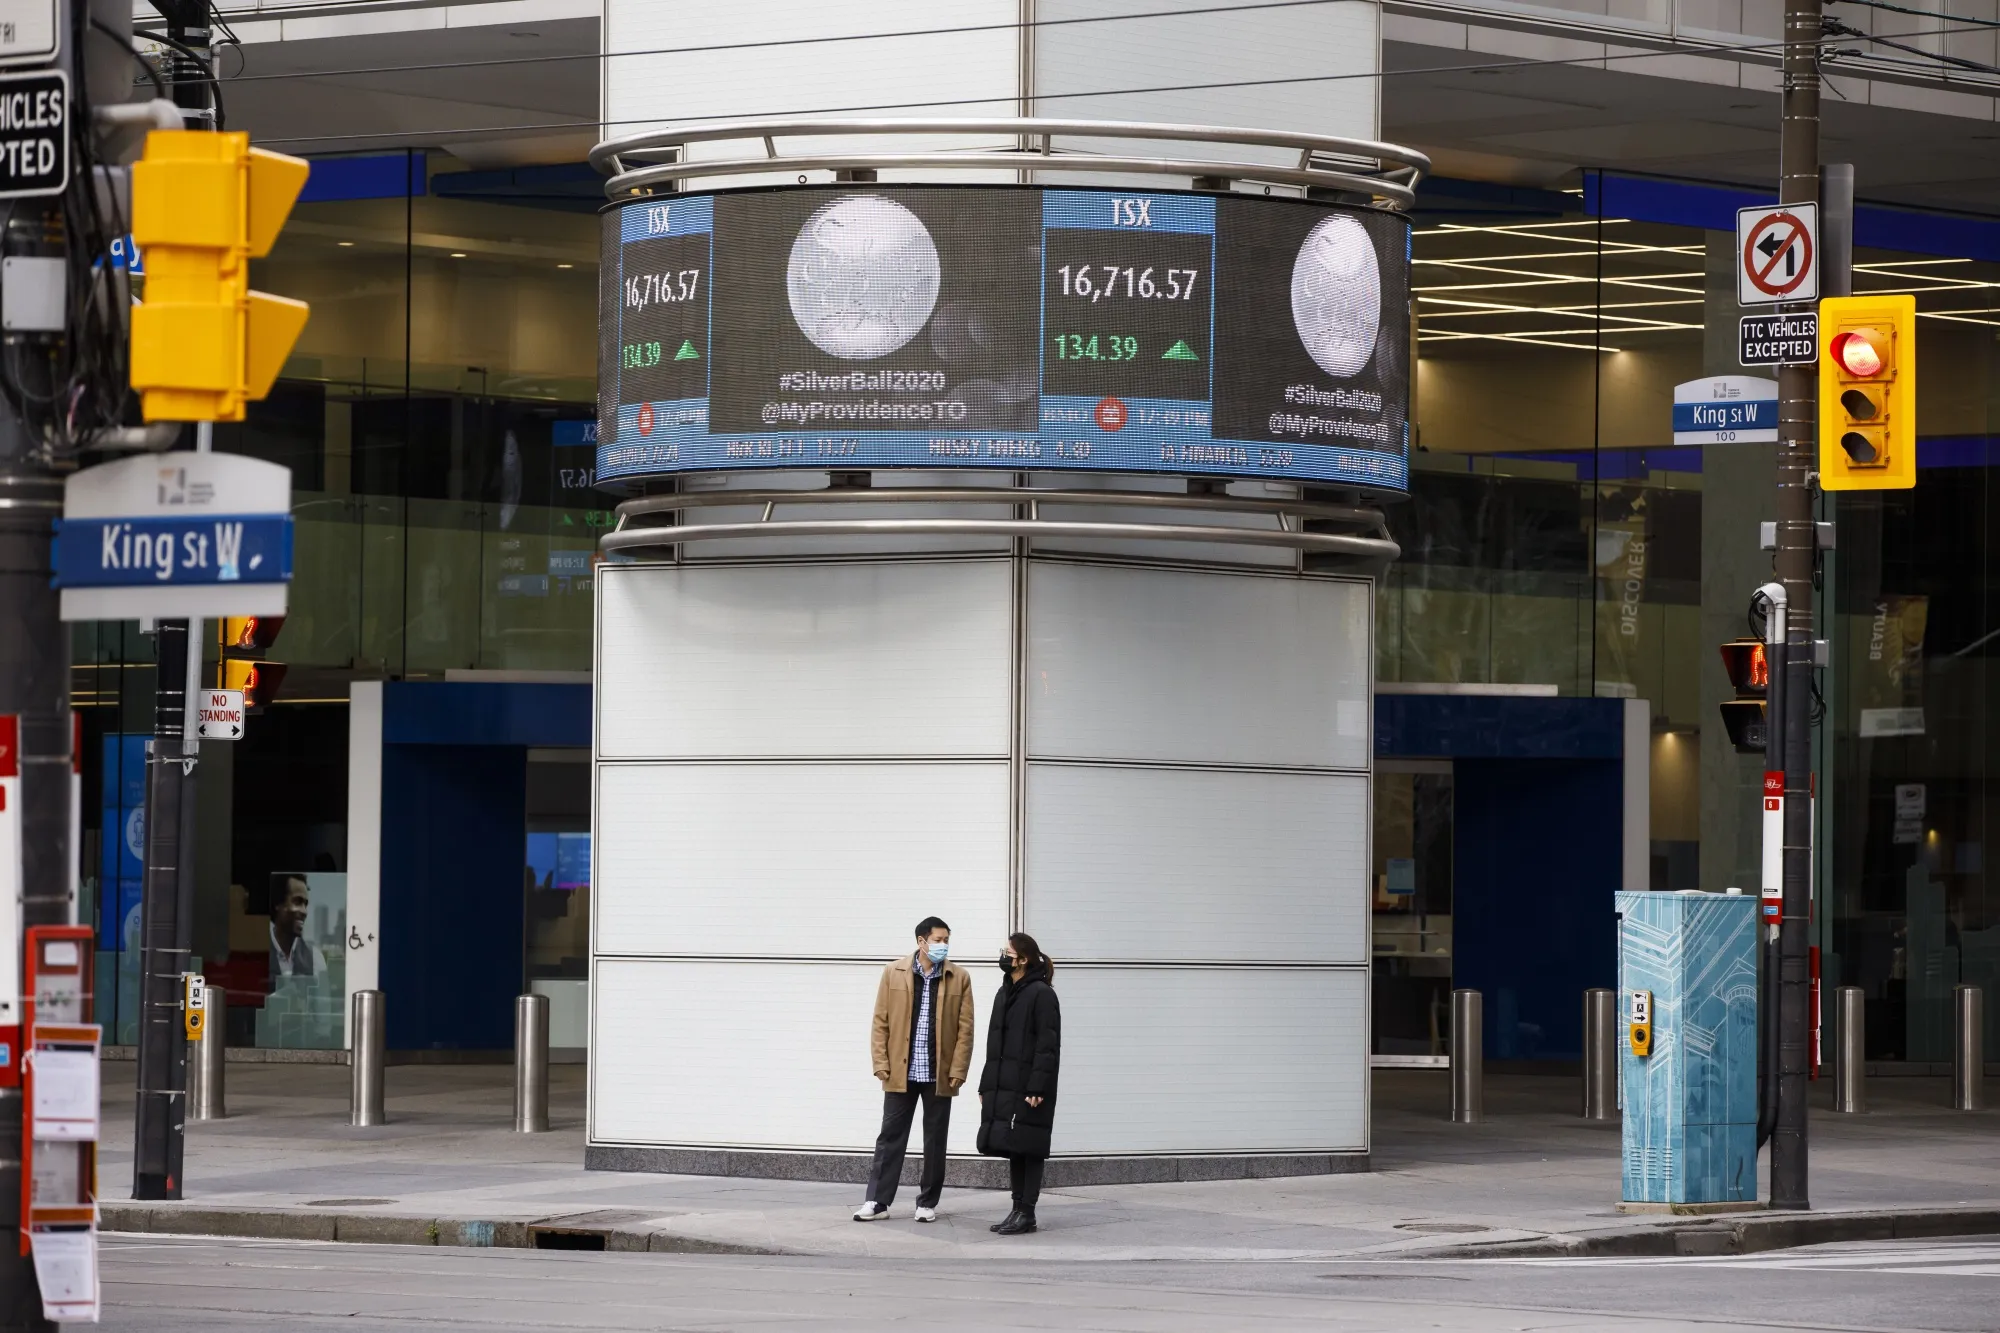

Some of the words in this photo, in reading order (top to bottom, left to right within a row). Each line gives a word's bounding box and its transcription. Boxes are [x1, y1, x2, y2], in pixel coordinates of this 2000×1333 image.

[647, 206, 670, 234] TSX
[1111, 199, 1152, 227] TSX
[110, 233, 141, 268] ay
[625, 269, 699, 312] 16,716.57
[1057, 264, 1198, 303] 16,716.57
[1743, 323, 1764, 339] TTC
[1768, 320, 1816, 338] VEHICLES
[623, 342, 661, 369] 134.39
[1054, 334, 1138, 361] 134.39
[1745, 340, 1812, 358] EXCEPTED
[778, 371, 946, 392] #SilverBall2020
[762, 399, 967, 425] @MyProvidenceTO
[1284, 385, 1382, 412] #SilverBall2020
[1269, 412, 1389, 440] @MyProvidenceTO
[1693, 405, 1726, 427] King
[1730, 408, 1742, 423] St
[1745, 404, 1757, 422] W
[1715, 431, 1736, 442] 100
[102, 524, 175, 580] King
[182, 531, 208, 569] St
[215, 522, 244, 568] W
[212, 694, 227, 707] NO
[199, 709, 241, 723] STANDING
